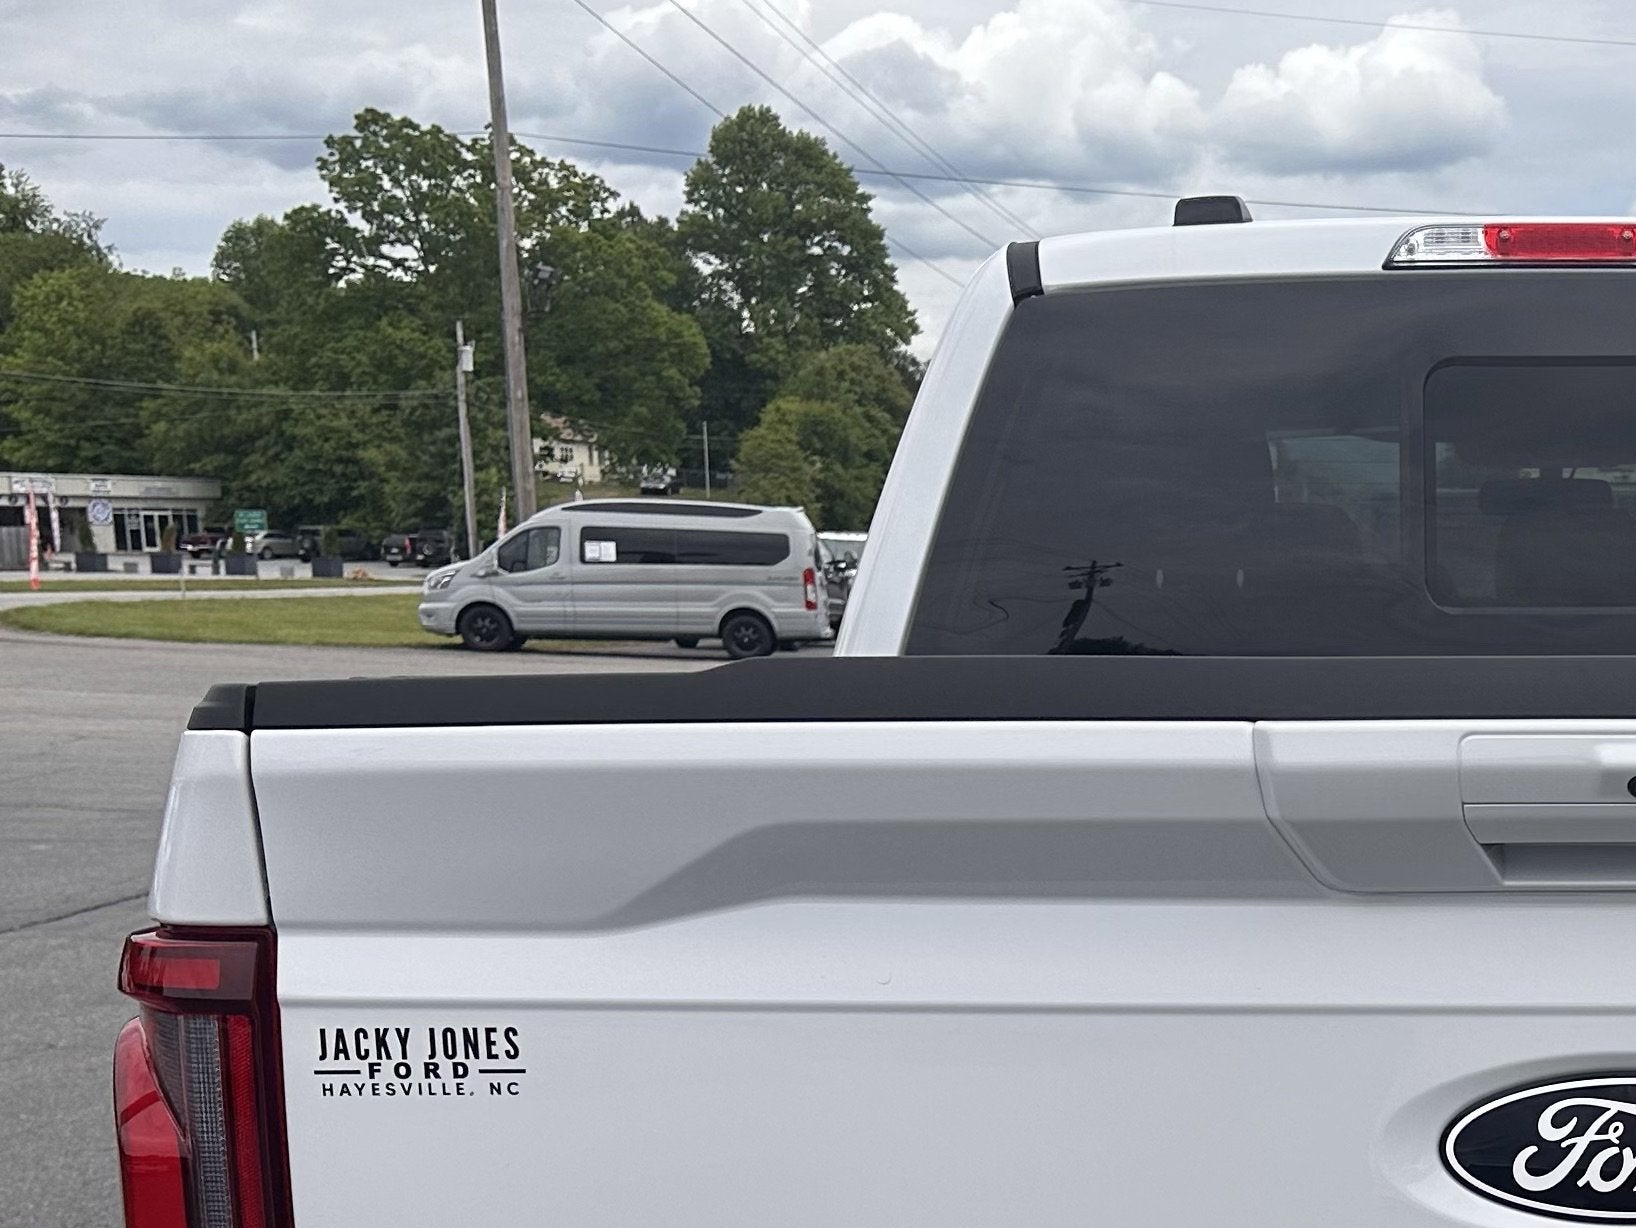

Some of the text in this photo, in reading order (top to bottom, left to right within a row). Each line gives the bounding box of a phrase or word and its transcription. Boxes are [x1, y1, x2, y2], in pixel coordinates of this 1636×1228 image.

[319, 1026, 520, 1061] JACKY JONES
[367, 1061, 469, 1080] FORD
[489, 1081, 520, 1096] NC
